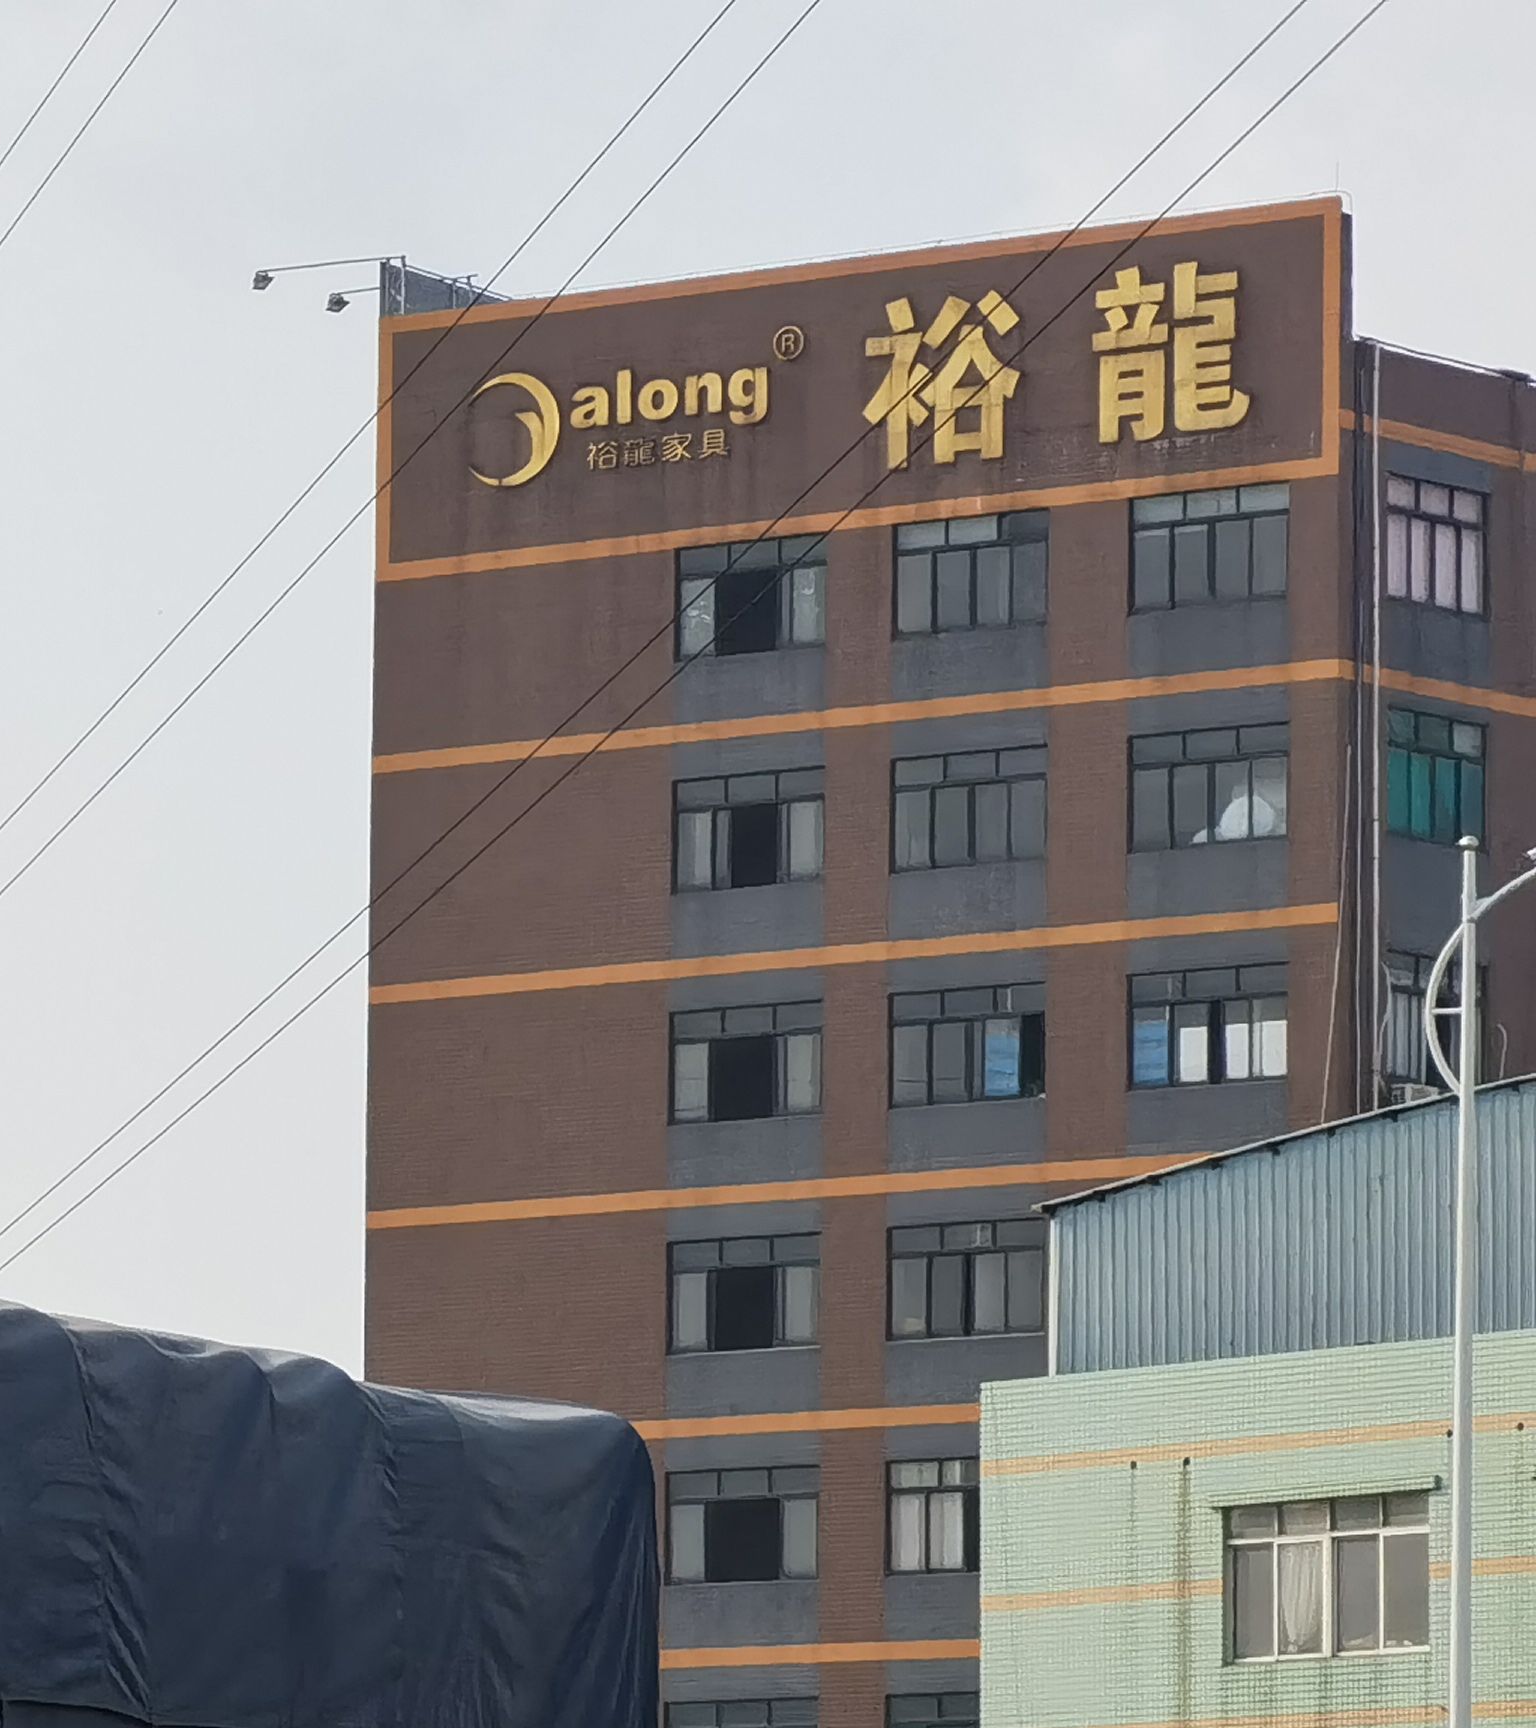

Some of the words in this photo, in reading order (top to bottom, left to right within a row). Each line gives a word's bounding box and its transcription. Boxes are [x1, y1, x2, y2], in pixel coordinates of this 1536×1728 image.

[862, 262, 1250, 469] 裕龍
[587, 429, 729, 471] 裕龍家具
